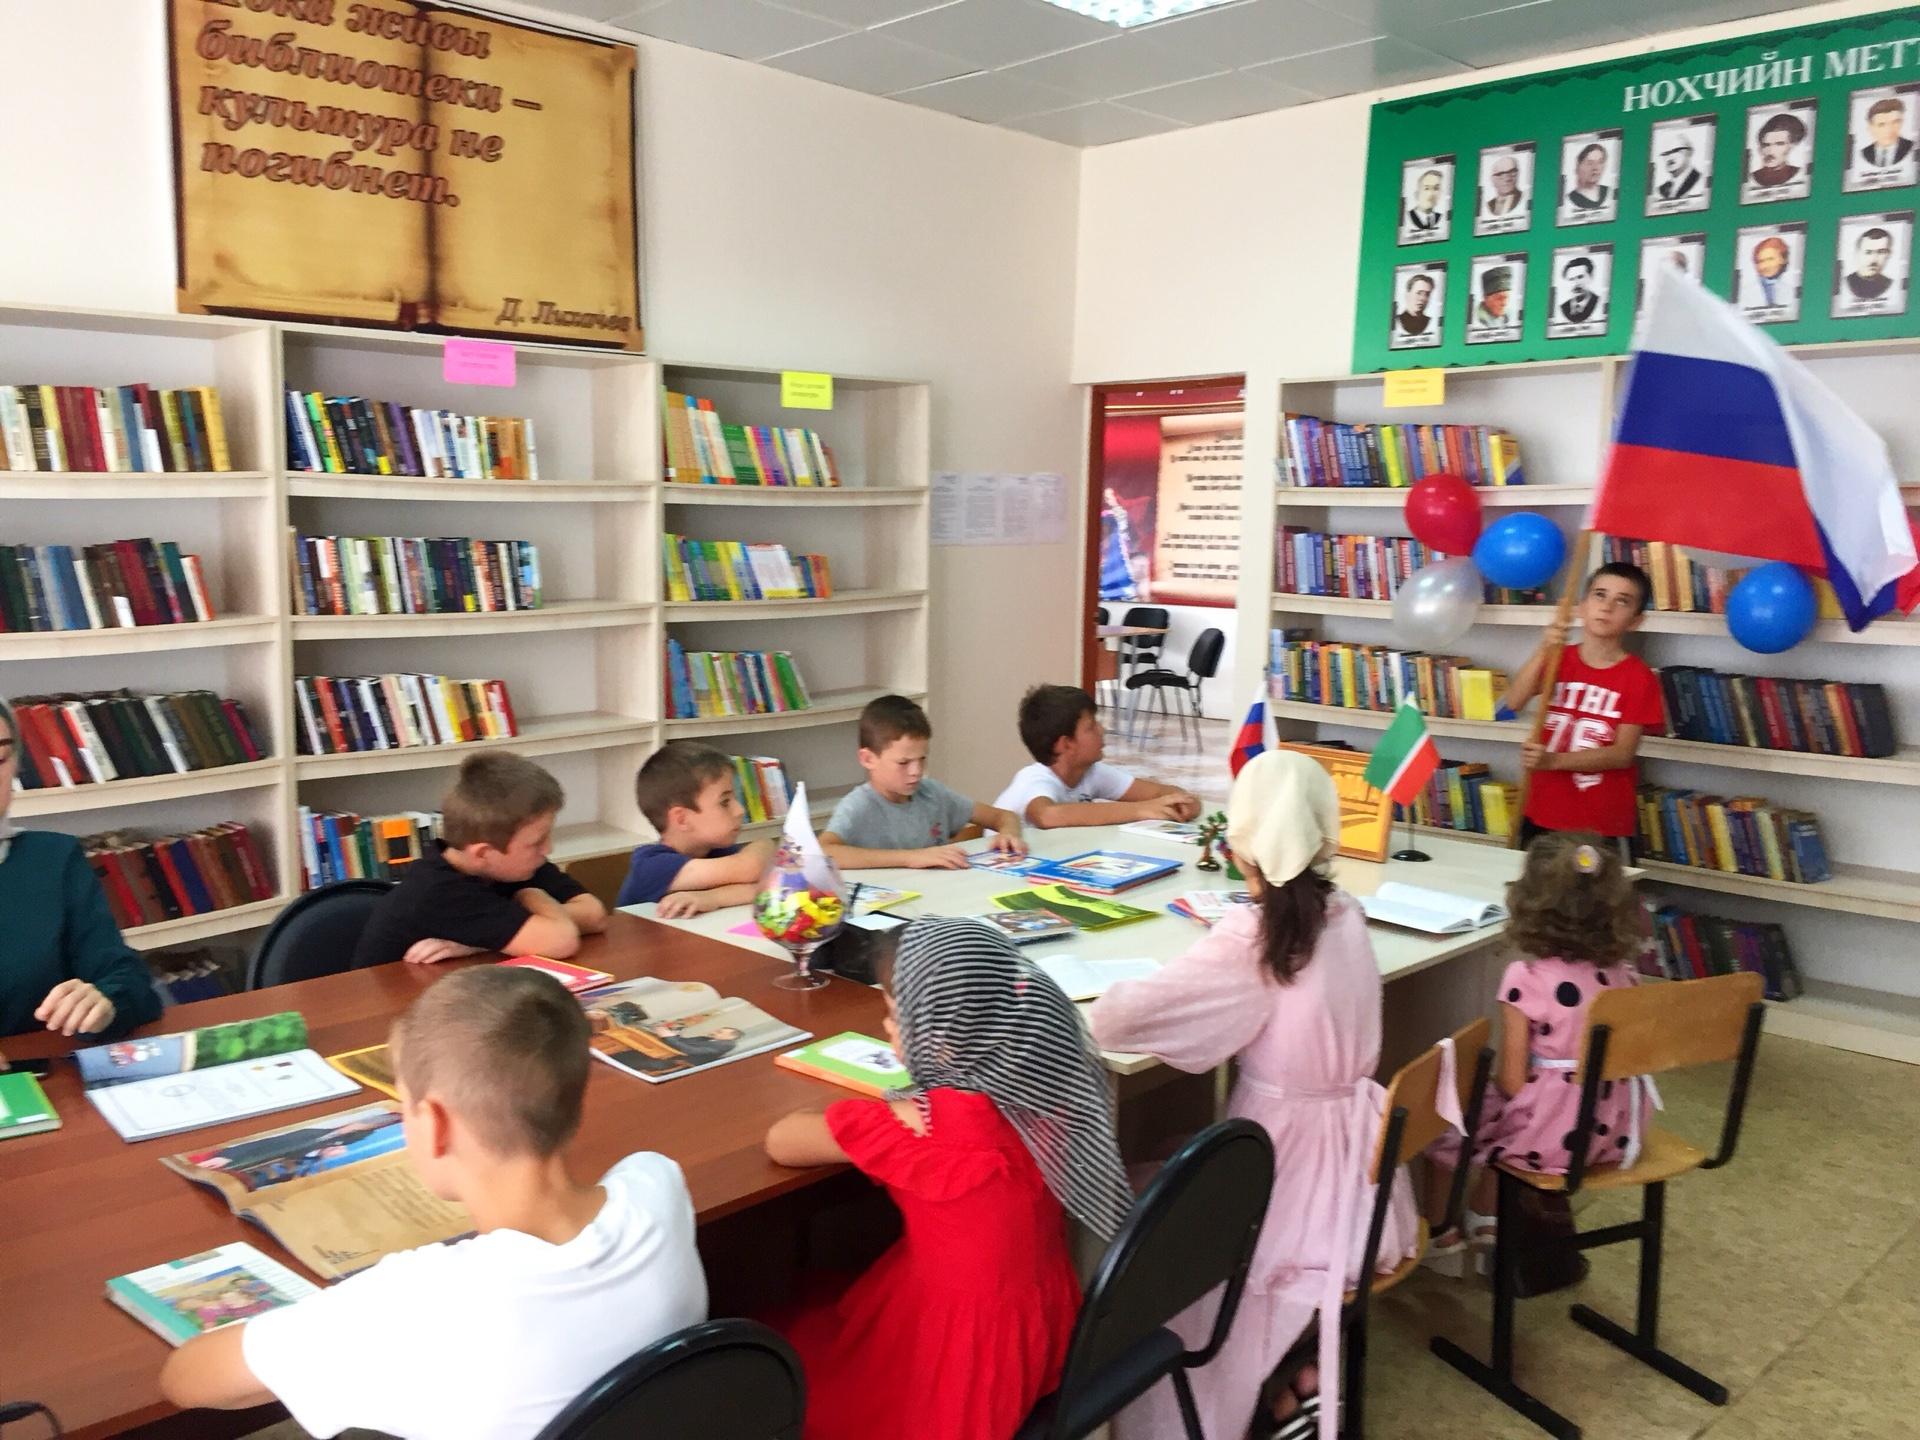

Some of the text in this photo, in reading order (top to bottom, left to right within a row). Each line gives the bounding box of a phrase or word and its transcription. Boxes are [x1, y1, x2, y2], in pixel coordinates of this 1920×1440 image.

[344, 3, 492, 60] живы
[195, 18, 503, 114] библиотеки
[1622, 51, 1814, 112] НОХЧИЙН
[198, 85, 505, 163] культура не
[201, 141, 461, 208] погибнет.
[494, 297, 525, 327] Д.
